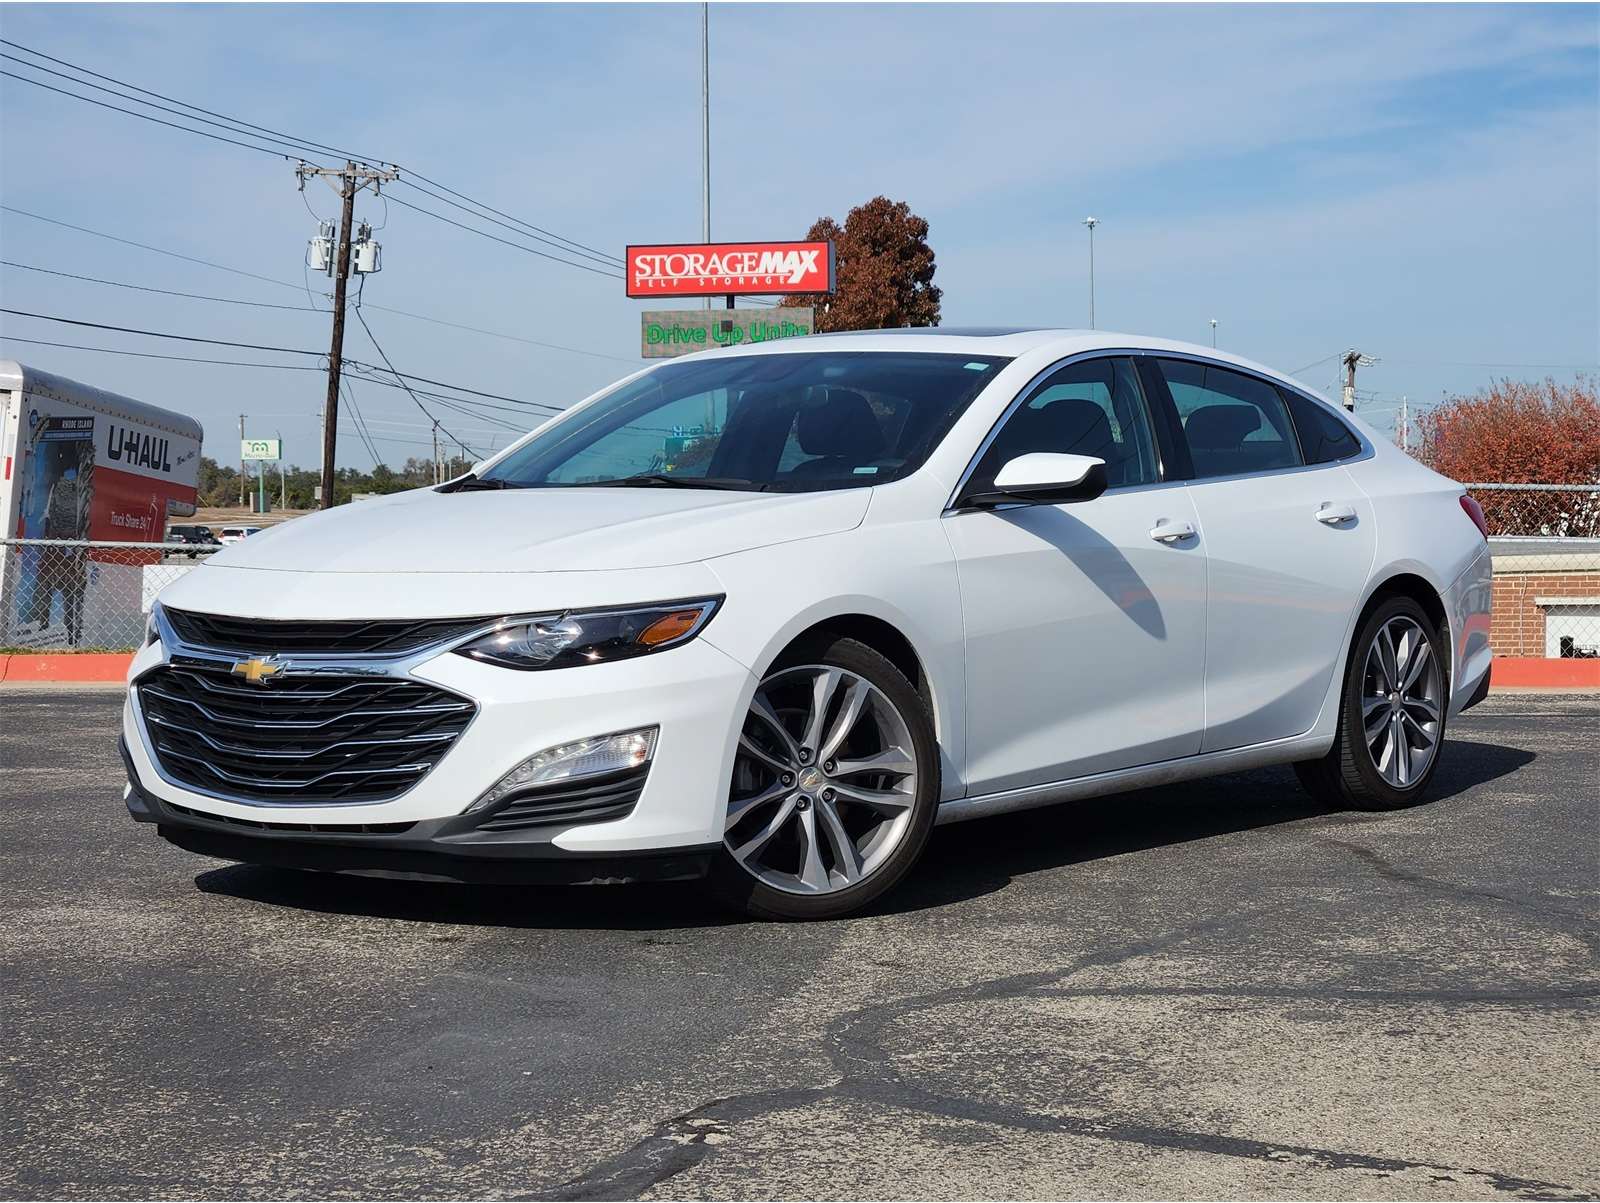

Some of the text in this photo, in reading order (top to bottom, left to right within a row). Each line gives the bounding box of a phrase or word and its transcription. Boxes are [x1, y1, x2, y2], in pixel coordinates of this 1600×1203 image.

[634, 250, 819, 284] STORAGEMAX
[635, 275, 785, 288] SELF STORAGE
[647, 320, 809, 345] Drive Up Units
[77, 419, 93, 429] ISLAND
[111, 511, 125, 527] Truck
[125, 513, 139, 528] Share
